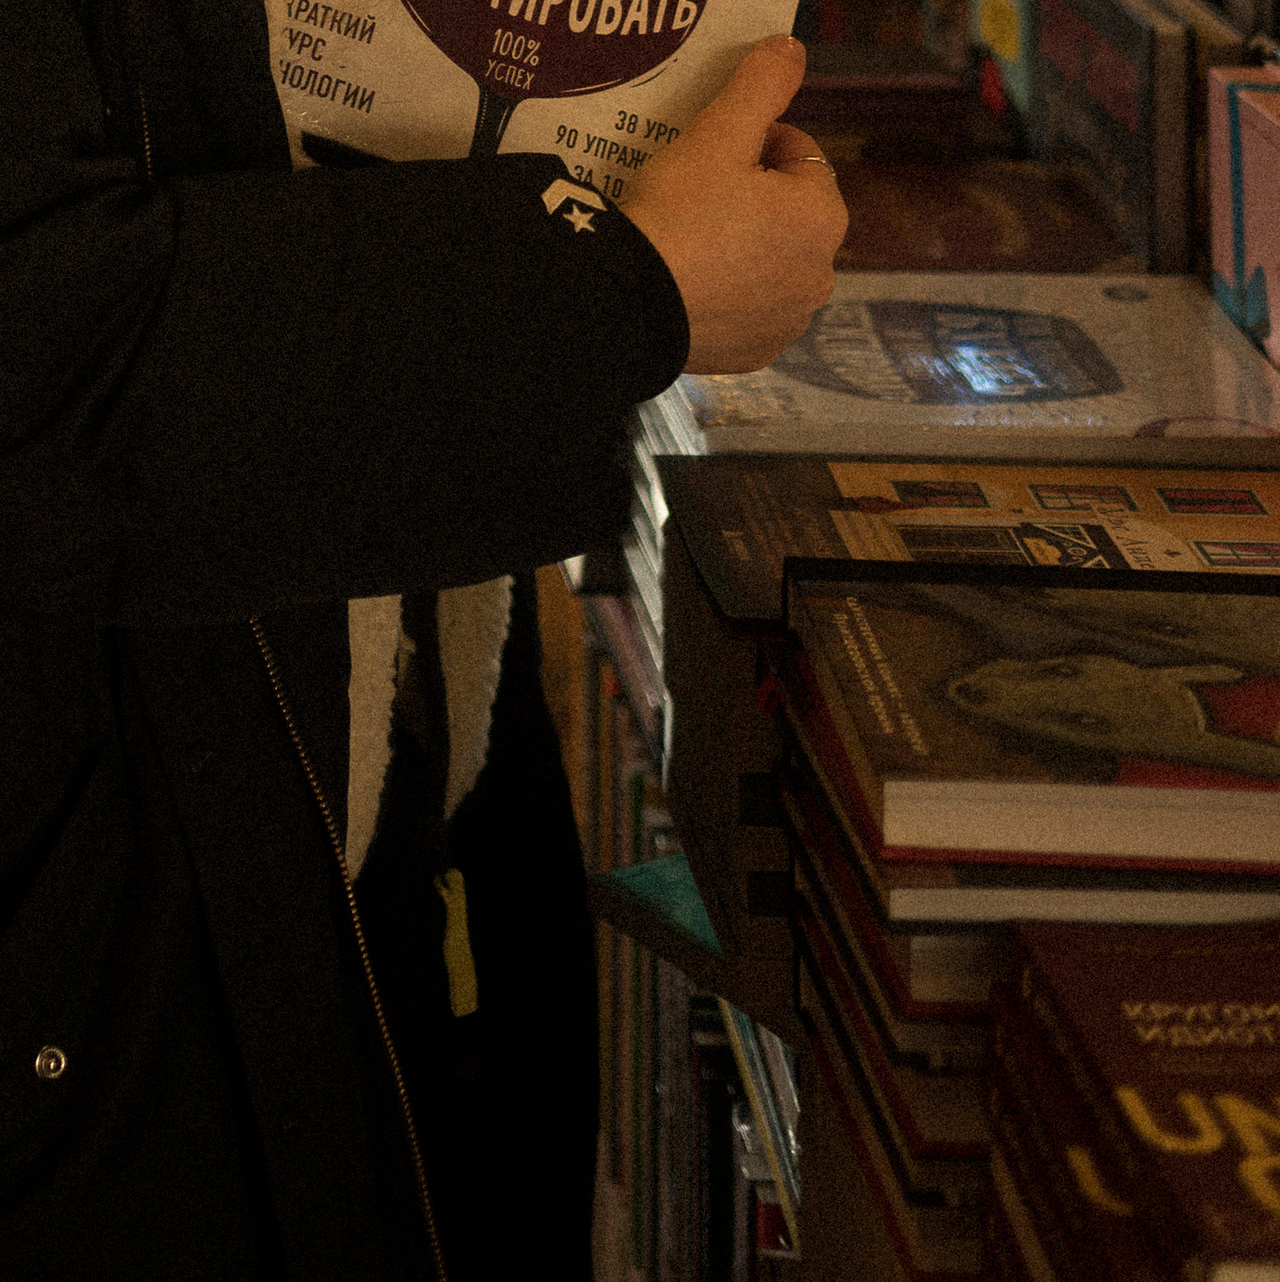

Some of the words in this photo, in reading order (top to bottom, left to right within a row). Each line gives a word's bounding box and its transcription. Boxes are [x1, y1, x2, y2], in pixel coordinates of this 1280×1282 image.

[282, 26, 327, 62] УРС
[491, 28, 542, 67] 100%
[484, 58, 536, 91] УСПЕХ
[554, 124, 578, 149] 90
[614, 110, 639, 135] 38
